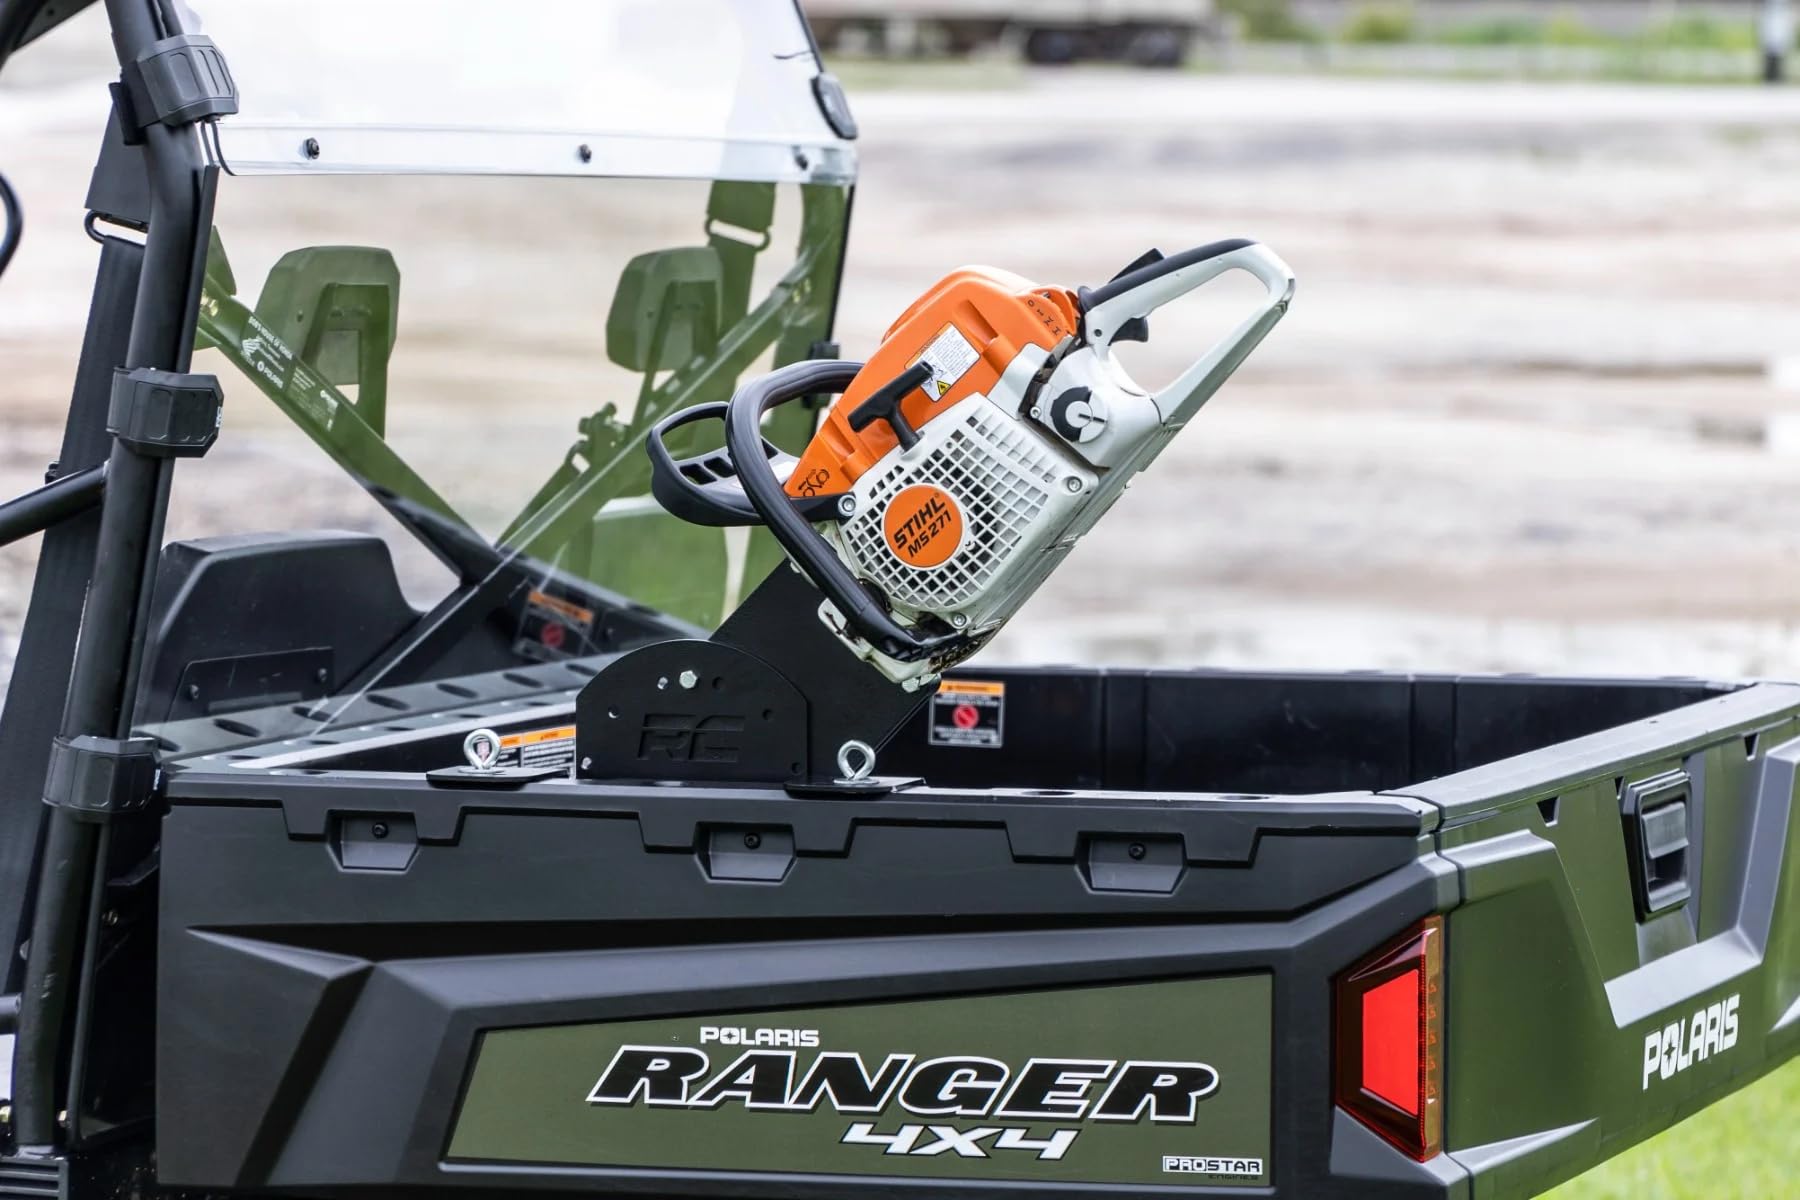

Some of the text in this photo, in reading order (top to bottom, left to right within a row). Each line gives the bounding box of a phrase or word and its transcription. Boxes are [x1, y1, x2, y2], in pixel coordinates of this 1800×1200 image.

[893, 497, 946, 549] STIHL
[700, 1026, 819, 1047] POLARIS
[1643, 994, 1740, 1090] POLARIS
[586, 1045, 1219, 1124] RANGER
[1164, 1157, 1261, 1173] PROSTAR
